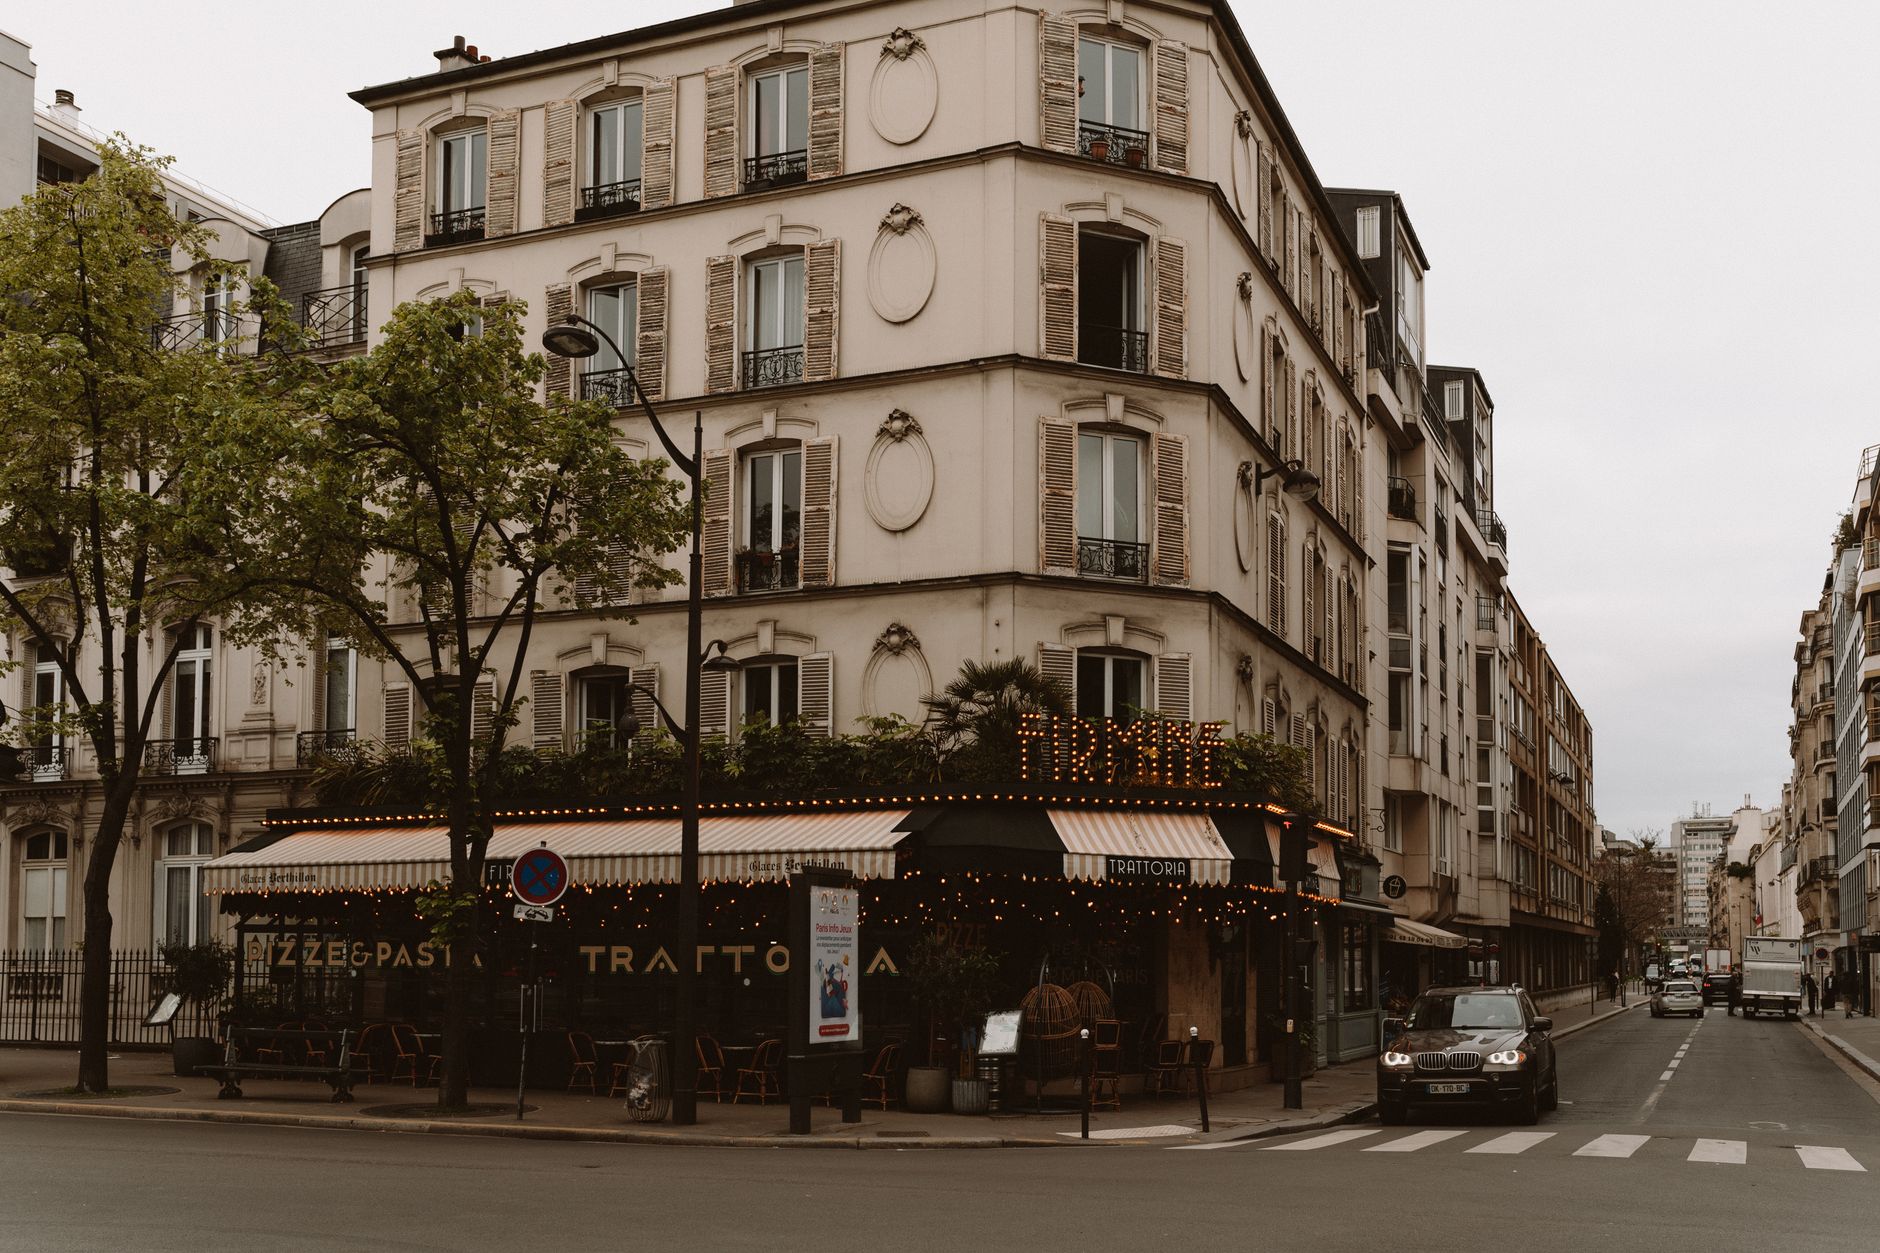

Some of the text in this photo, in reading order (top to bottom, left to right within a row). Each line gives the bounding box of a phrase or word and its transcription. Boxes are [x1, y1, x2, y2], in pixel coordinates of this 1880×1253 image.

[1016, 713, 1227, 788] FIRMINE
[749, 860, 780, 873] Glaces
[1109, 859, 1186, 876] TRATTORIA
[241, 872, 316, 884] Glaces Berthillon
[816, 923, 852, 934] Paris Info Jeux
[937, 922, 987, 949] PIZZE
[580, 945, 899, 976] TRATTOA
